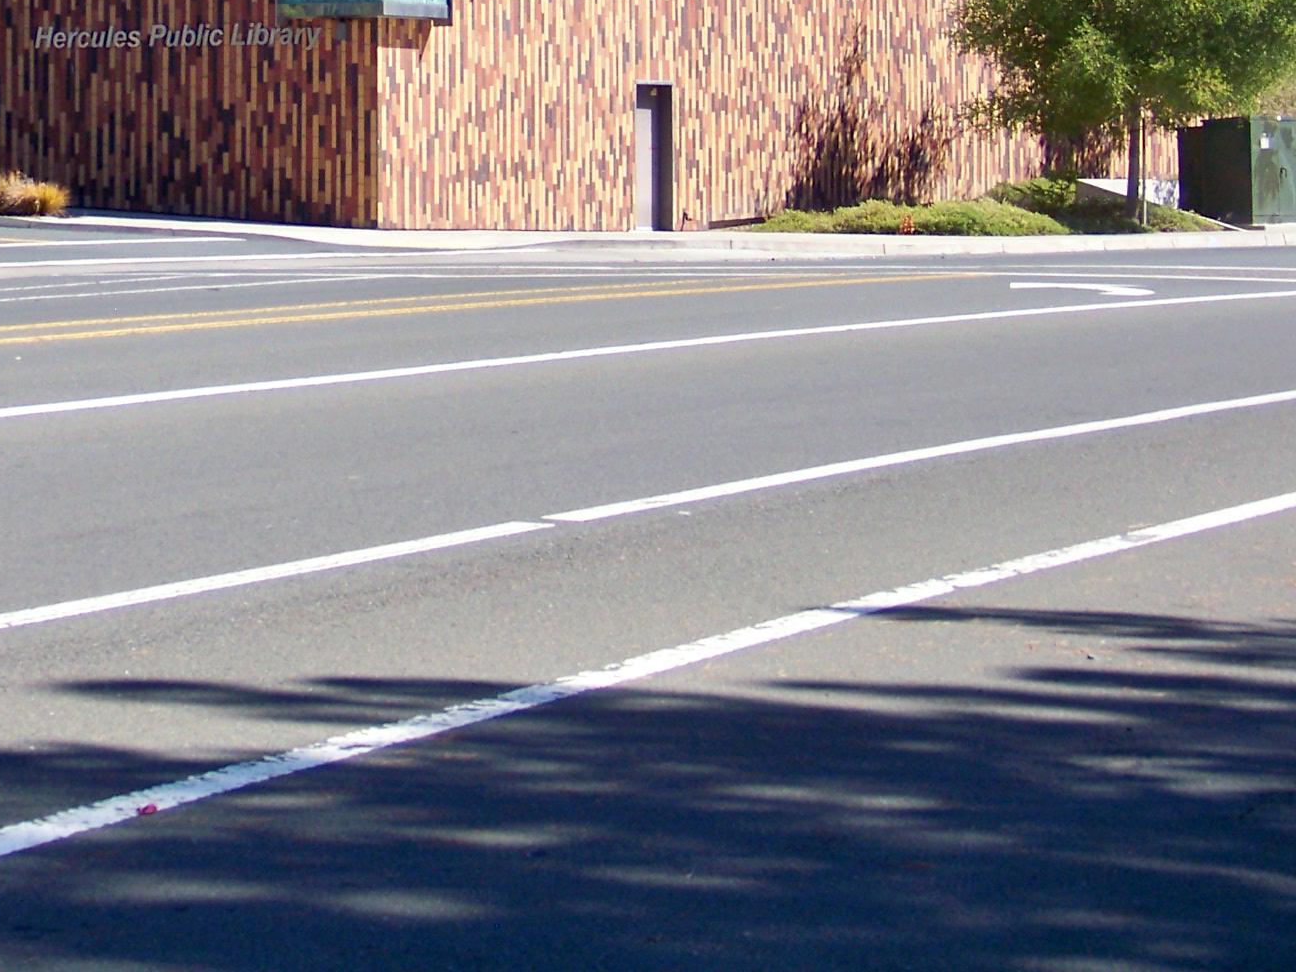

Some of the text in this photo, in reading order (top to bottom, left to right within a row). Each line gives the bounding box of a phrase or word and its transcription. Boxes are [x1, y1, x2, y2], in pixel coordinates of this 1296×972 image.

[35, 22, 322, 51] Hercules Public Library
